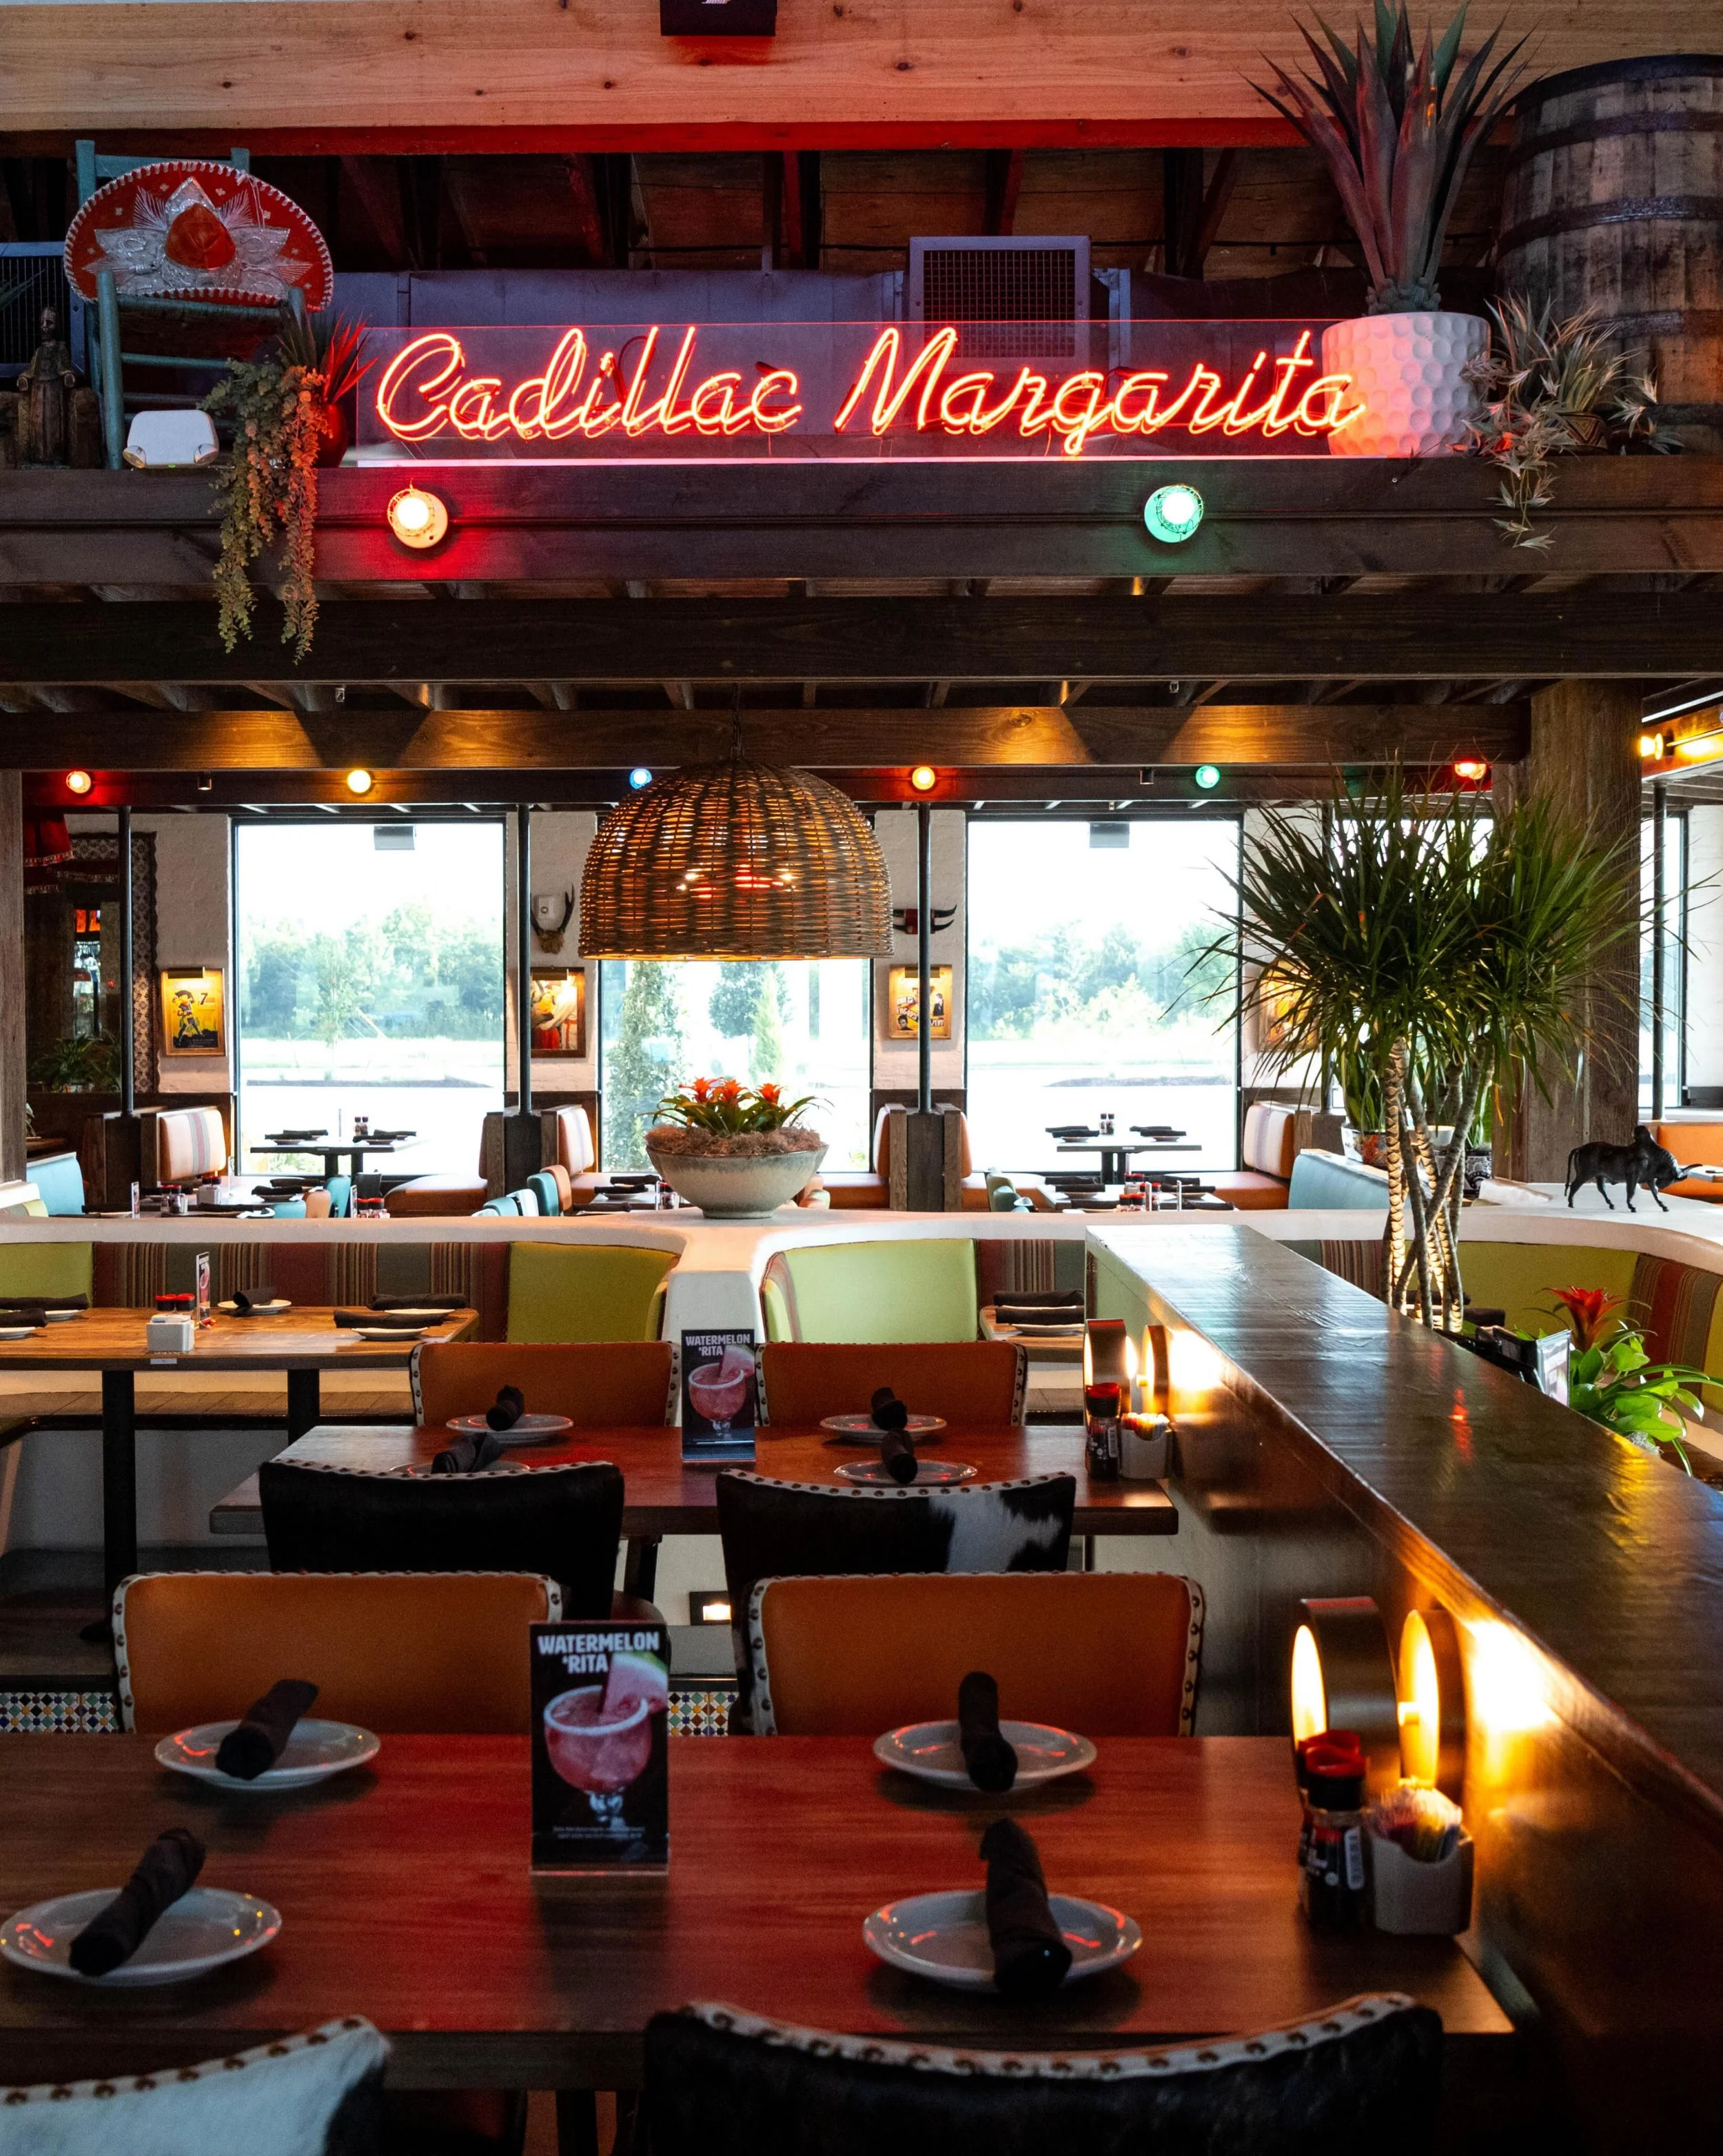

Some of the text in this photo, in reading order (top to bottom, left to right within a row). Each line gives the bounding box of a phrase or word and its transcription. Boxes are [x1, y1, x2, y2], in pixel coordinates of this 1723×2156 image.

[376, 326, 1367, 454] Cadillac Margarita
[686, 1334, 750, 1346] WATERMELON
[538, 1631, 660, 1655] WATERMELON
